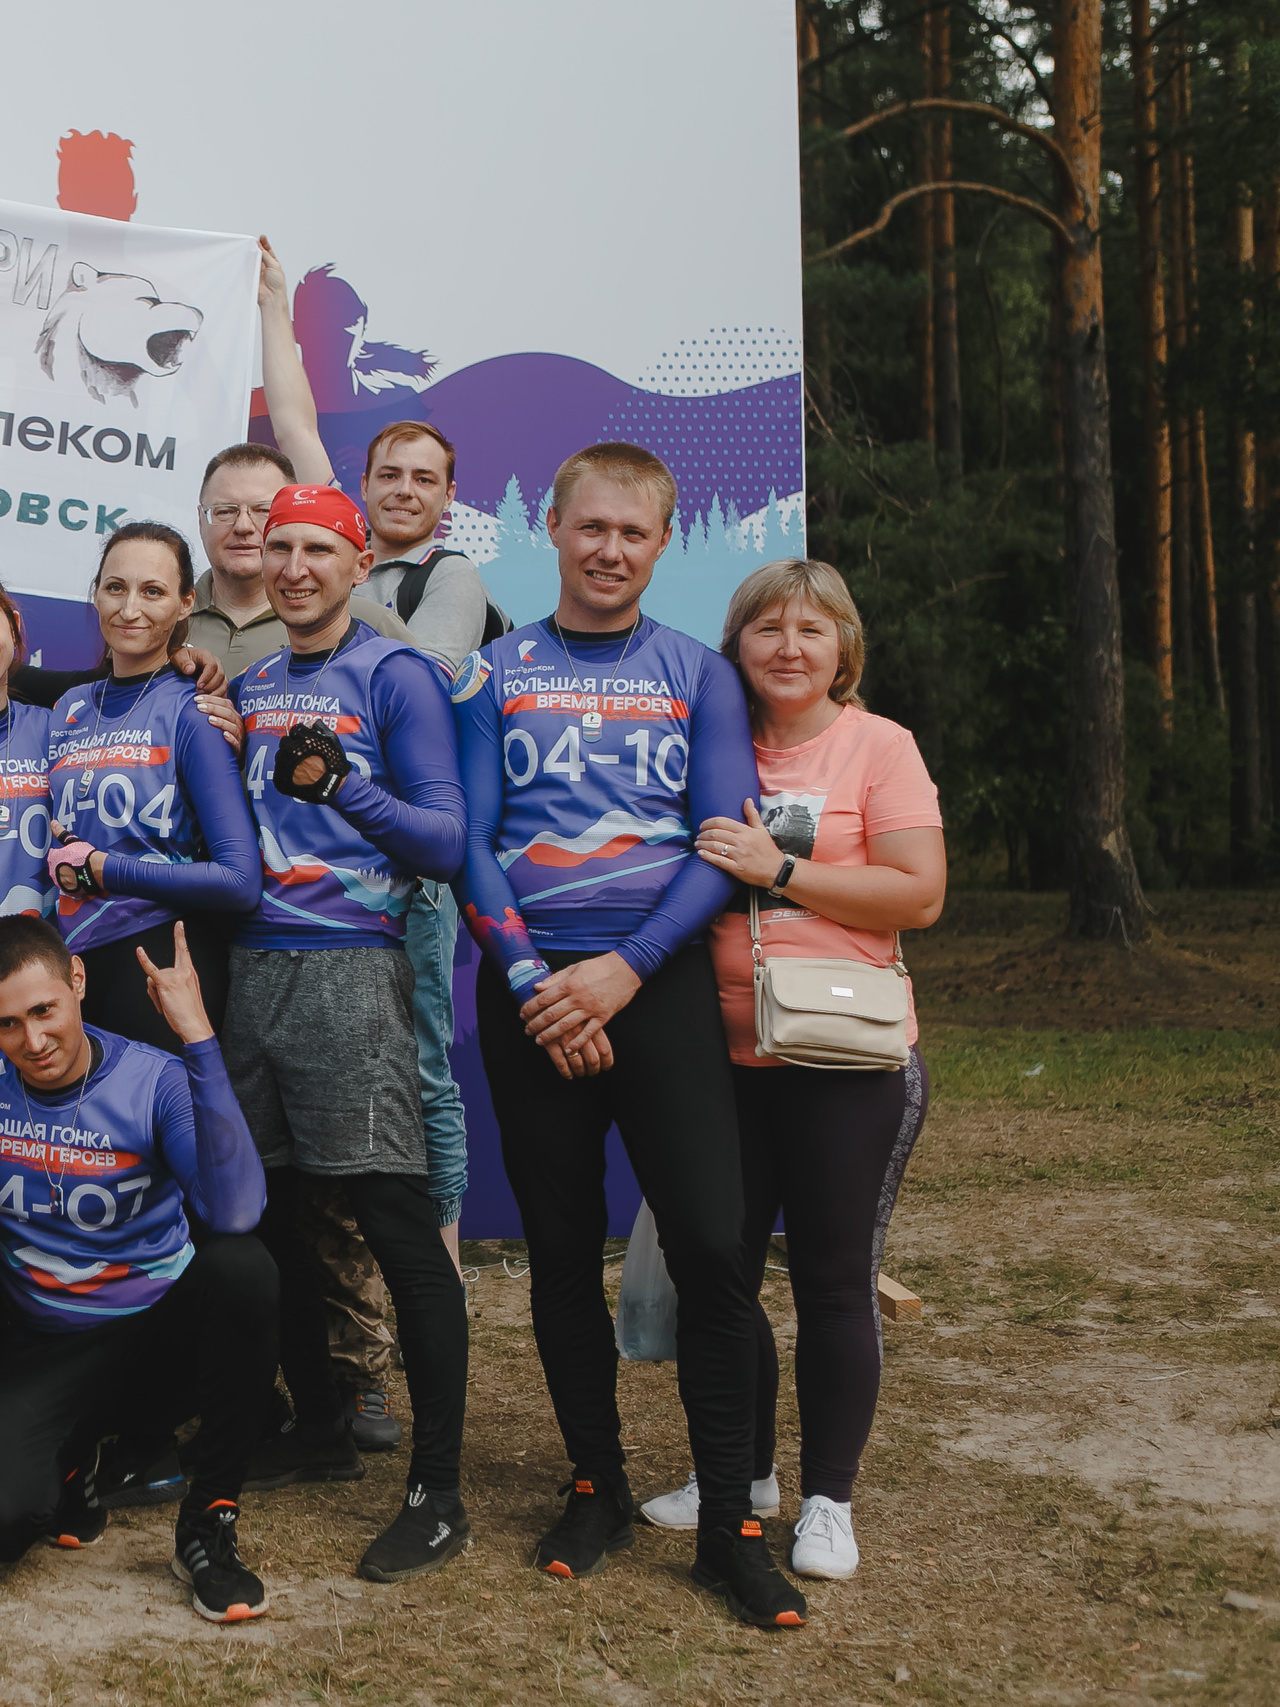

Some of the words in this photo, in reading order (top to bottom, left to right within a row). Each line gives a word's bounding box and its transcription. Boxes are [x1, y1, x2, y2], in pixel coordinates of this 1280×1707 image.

[502, 677, 596, 697] БОЛЬШАЯ
[602, 678, 671, 696] ГОНКА
[240, 694, 294, 716] БОЛЬШАЯ
[294, 694, 340, 714] ГОНКА
[536, 694, 599, 710] ВРЕМЯ
[603, 696, 673, 714] ГЕРОЕВ
[255, 712, 289, 729] ВРЕМЯ
[289, 713, 339, 731] ГЕРЕВ
[48, 732, 107, 761] БОЛЬШАЯ
[106, 729, 152, 746] ГОНКА
[100, 745, 151, 762] ГЕРОЕВ
[503, 725, 690, 793] 04-10
[2, 774, 49, 790] ГЕРОЕ
[57, 773, 176, 838] 4-04
[771, 910, 813, 919] DEMIX
[50, 1125, 113, 1150] ГОНКА
[49, 1146, 117, 1167] ГЕРОЕВ
